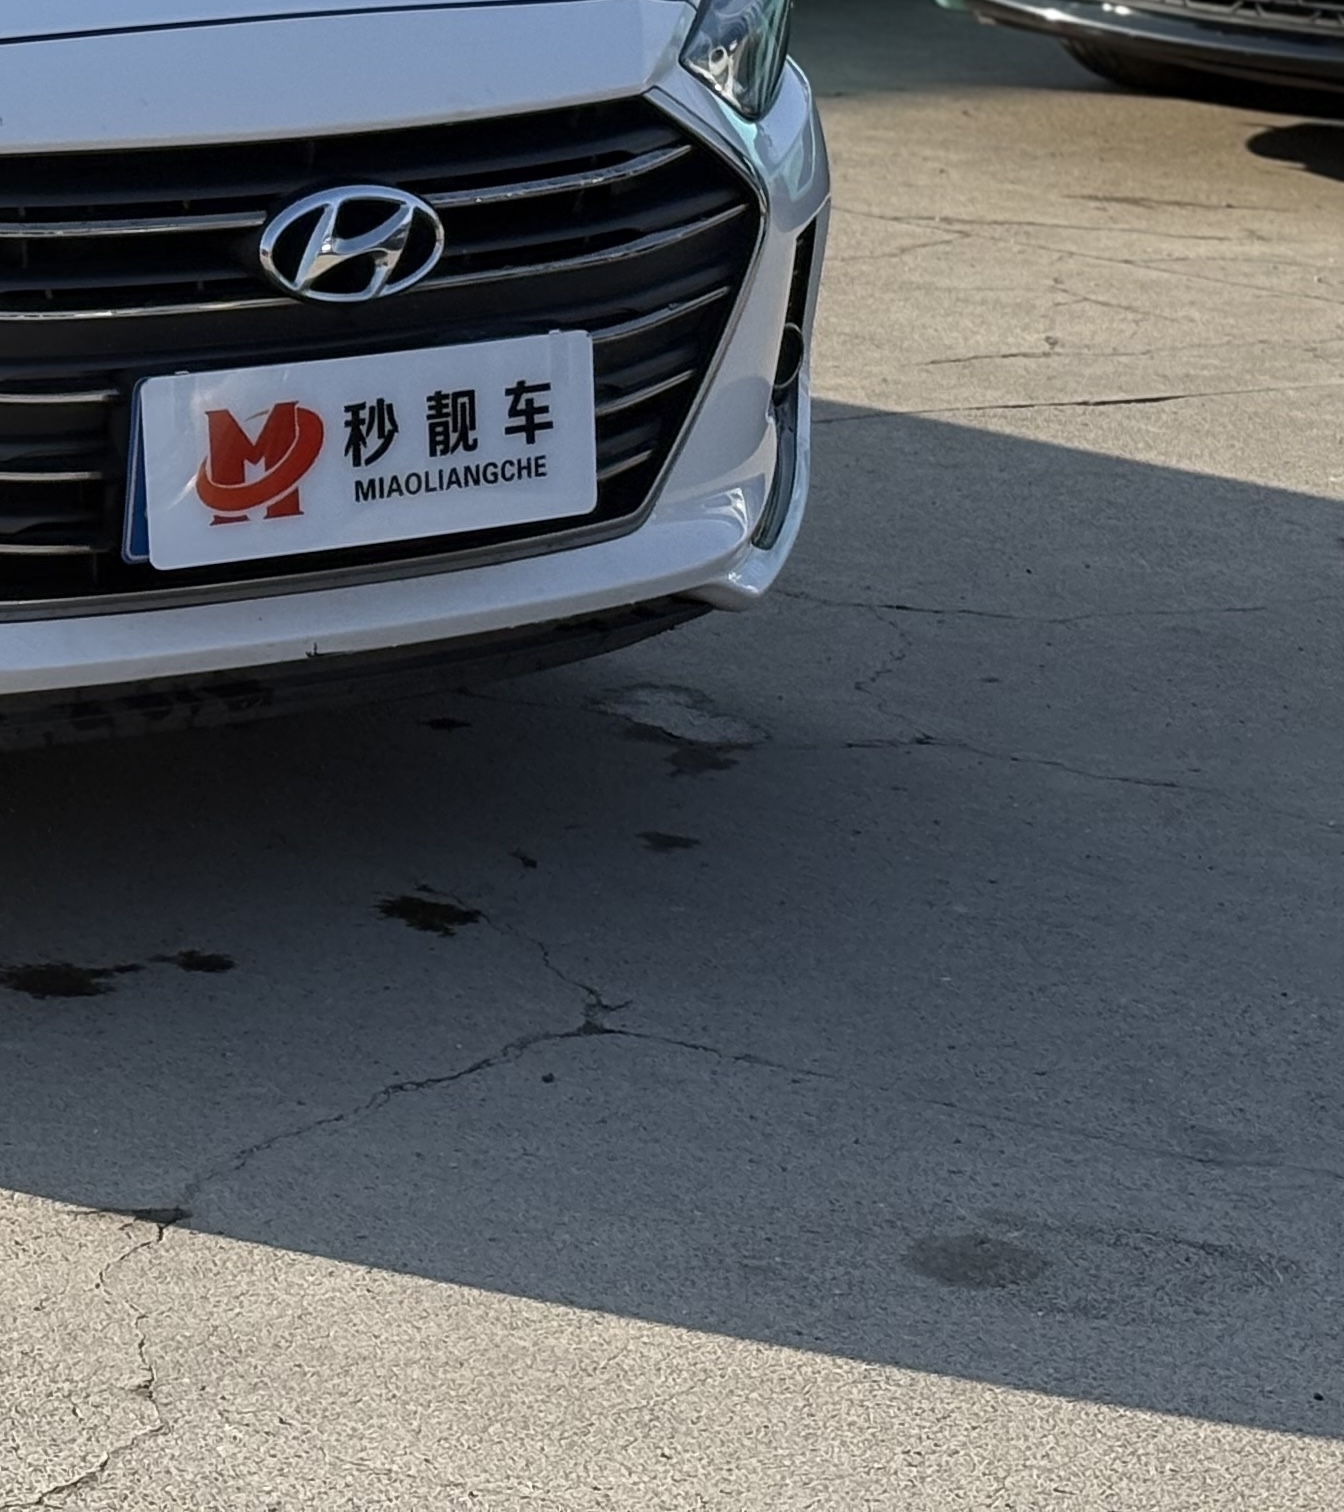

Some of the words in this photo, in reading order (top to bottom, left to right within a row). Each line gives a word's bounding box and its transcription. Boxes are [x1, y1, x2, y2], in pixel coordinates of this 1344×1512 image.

[344, 380, 554, 468] 秒靓车
[354, 455, 548, 503] MIAOLIANGCHE
